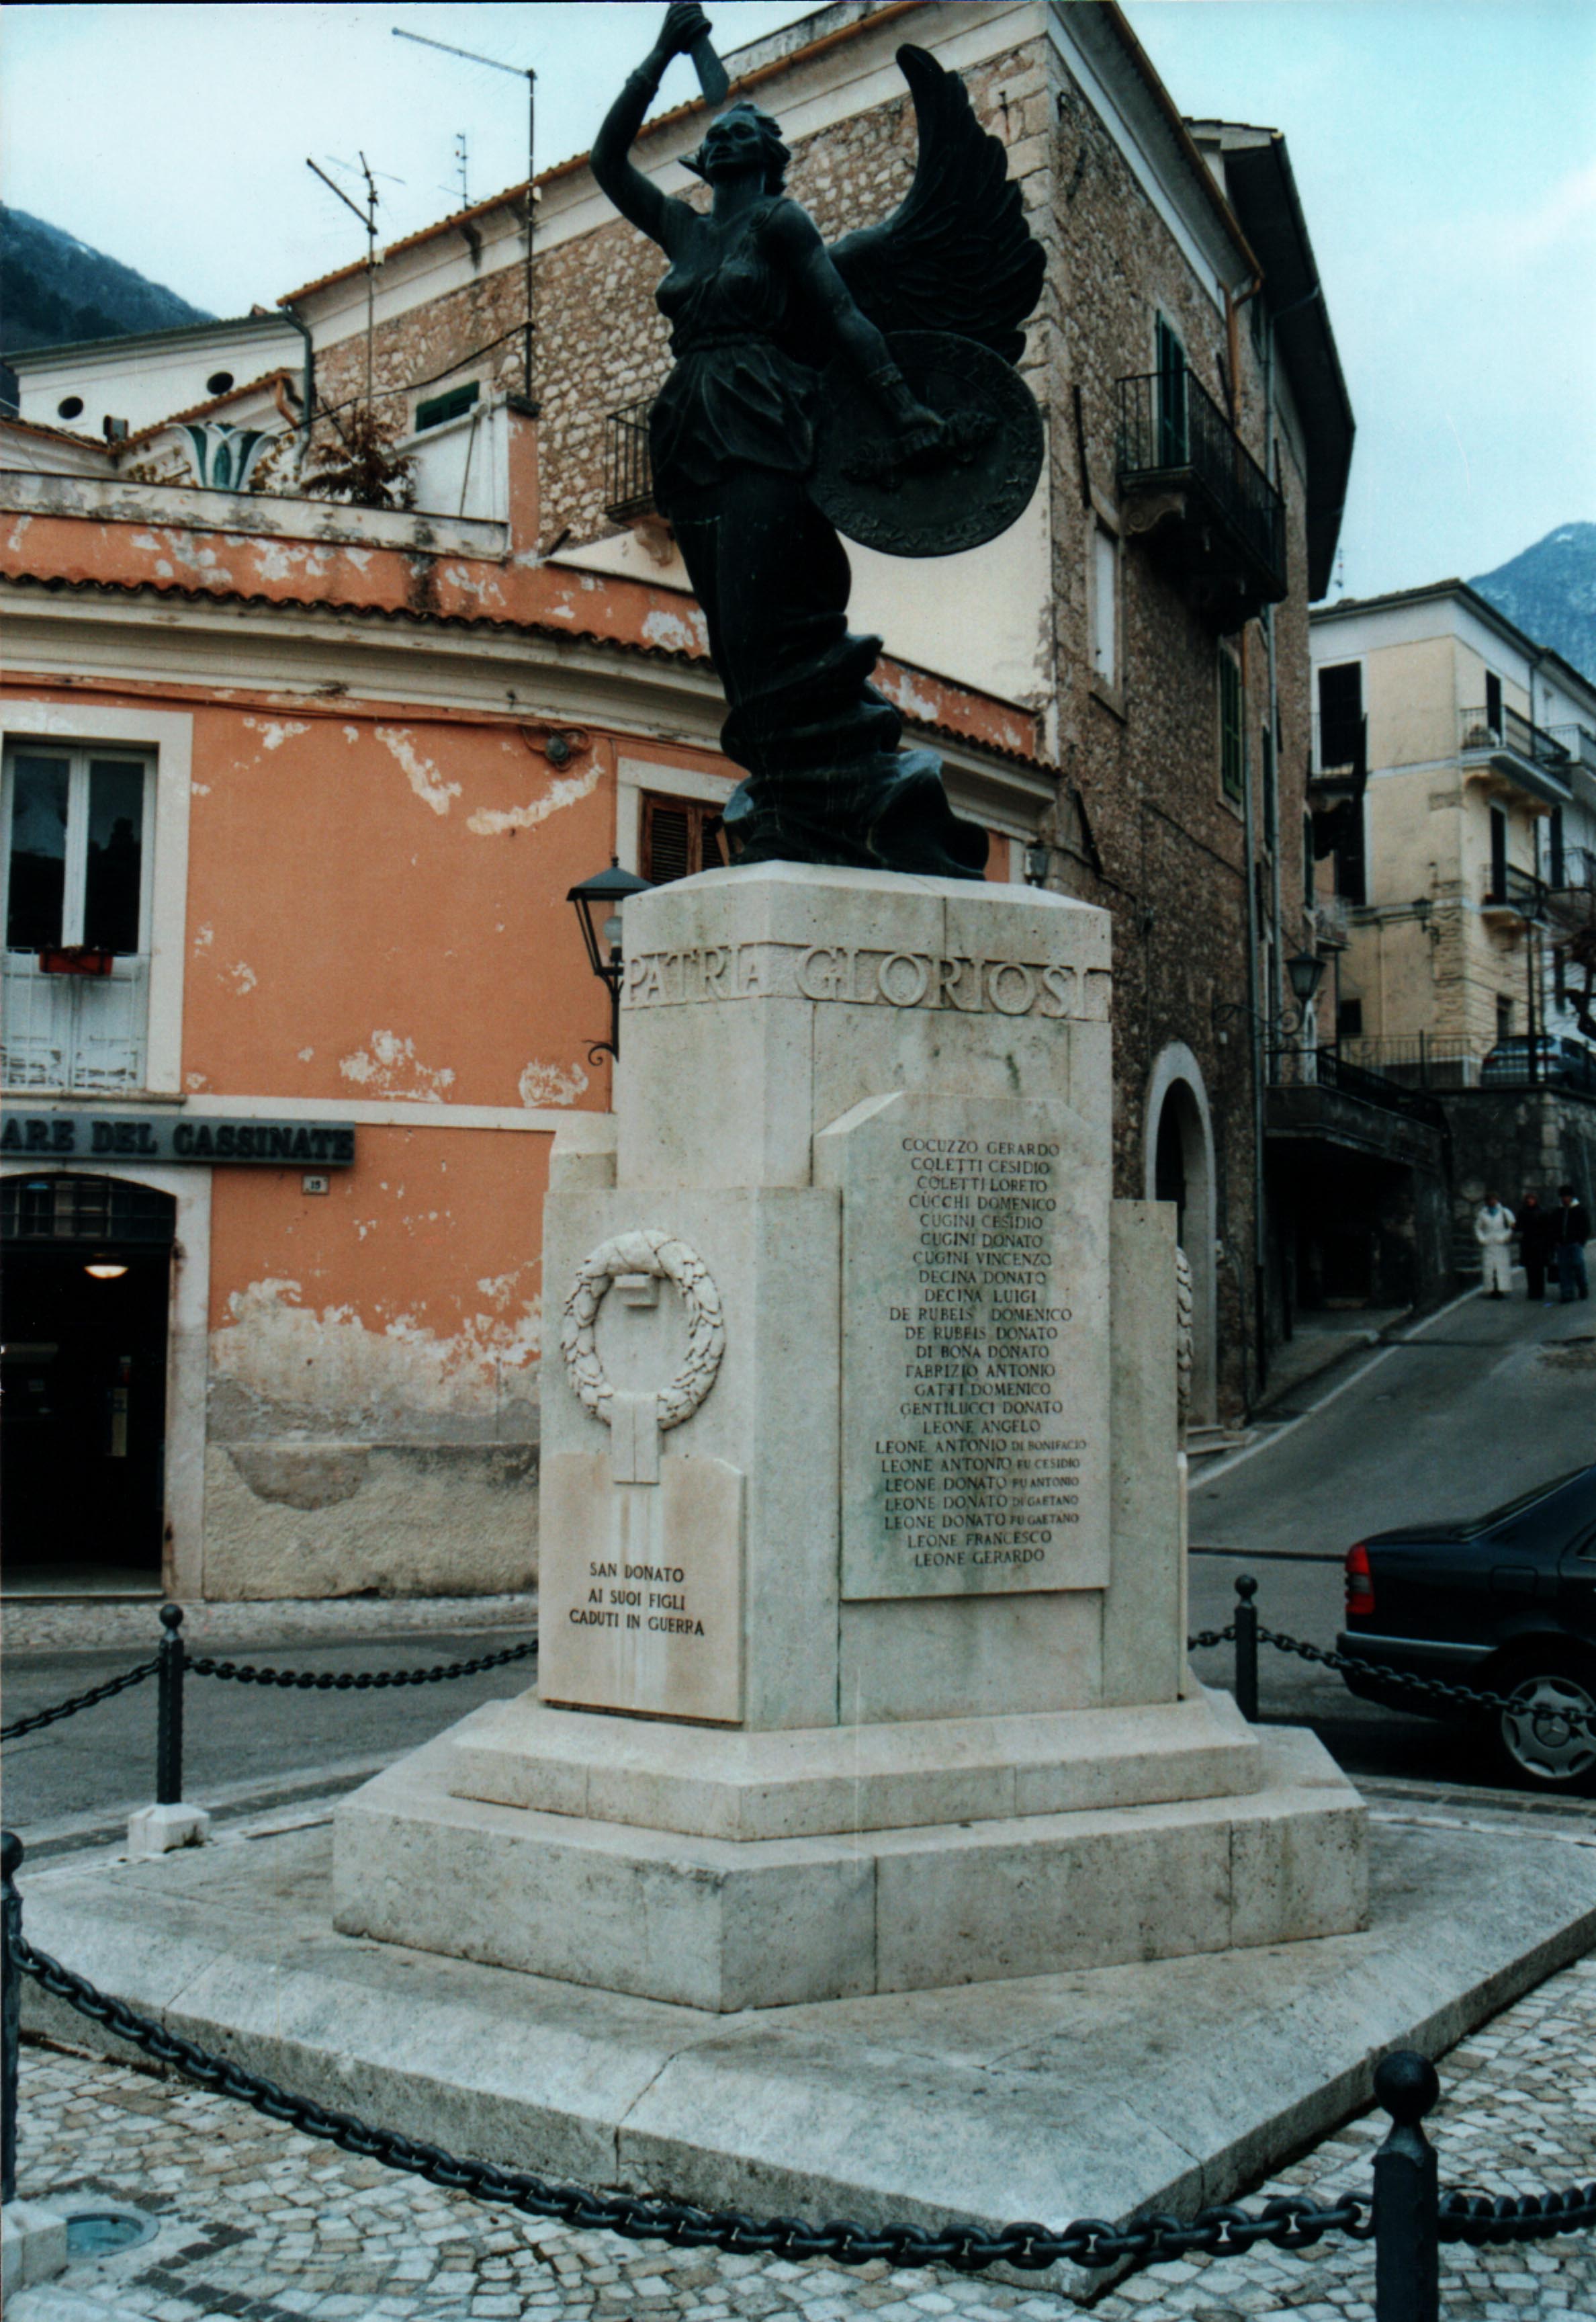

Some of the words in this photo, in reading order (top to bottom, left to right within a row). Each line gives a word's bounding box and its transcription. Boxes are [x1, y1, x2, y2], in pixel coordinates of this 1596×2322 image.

[624, 943, 767, 1008] PATRIA
[795, 944, 1089, 1020] GLORIOSI
[91, 1121, 157, 1154] DEL
[173, 1123, 354, 1160] CASSINATE
[902, 1138, 978, 1154] COCUZZO
[987, 1142, 1059, 1156] GERARDO
[911, 1158, 982, 1173] COLETTI
[989, 1160, 1050, 1174] CESIDIO
[917, 1176, 984, 1191] COLETTI
[990, 1178, 1047, 1193] LORETO
[909, 1195, 969, 1209] CUCCHI
[978, 1197, 1056, 1211] DOMENICO
[920, 1214, 975, 1228] CUGINI
[982, 1215, 1043, 1229] CESIDIO
[921, 1233, 975, 1246] CUGINI
[983, 1234, 1043, 1248] DONATO
[913, 1252, 968, 1265] CUGINI
[975, 1252, 1051, 1266] VINCENZO
[920, 1271, 976, 1283] DECINA
[984, 1272, 1046, 1285] DONATO
[925, 1289, 982, 1303] DECINA
[994, 1290, 1036, 1303] LUIGI
[890, 1307, 910, 1320] DE
[919, 1307, 973, 1320] RUBEIS
[991, 1308, 1072, 1322] DOMENICO
[905, 1327, 925, 1340] DE
[934, 1327, 985, 1340] RUBEIS
[997, 1327, 1057, 1340] DONATO
[916, 1345, 932, 1358] DI
[941, 1345, 980, 1358] BONA
[989, 1345, 1049, 1358] DONATO
[906, 1365, 978, 1378] FABRIZIO
[986, 1364, 1055, 1377] ANTONIO
[915, 1383, 963, 1396] GATTI
[971, 1383, 1050, 1395] DOMENICO
[900, 1402, 994, 1416] GENTILUCCI
[1003, 1401, 1063, 1414] DONATO
[924, 1420, 973, 1434] LEONE
[981, 1420, 1040, 1433] ANGELO
[876, 1440, 926, 1454] LEONE
[935, 1439, 1007, 1453] ANTONIO
[1012, 1442, 1024, 1451] DI
[1028, 1439, 1087, 1451] BONIFACIO
[882, 1459, 932, 1473] LEONE
[940, 1458, 1011, 1471] ANTONIO
[1017, 1459, 1030, 1469] FU
[1034, 1458, 1080, 1469] CESIDIO
[885, 1478, 935, 1492] LEONE
[944, 1477, 1006, 1490] DONATO
[1013, 1478, 1026, 1488] FU
[1030, 1477, 1079, 1487] ANTONIO
[885, 1497, 935, 1512] LEONE
[944, 1495, 1007, 1509] DONATO
[1013, 1498, 1024, 1506] DI
[1028, 1495, 1079, 1506] GAETANO
[885, 1516, 935, 1530] LEONE
[942, 1514, 1005, 1528] DONATO
[1010, 1514, 1024, 1525] FU
[1028, 1513, 1079, 1524] GAETANO
[908, 1535, 957, 1548] LEONE
[966, 1531, 1051, 1545] FRANCESCO
[915, 1553, 964, 1567] LEONE
[973, 1549, 1045, 1565] GERARDO
[590, 1562, 617, 1577] SAN
[625, 1565, 684, 1582] DONATO
[588, 1588, 603, 1602] AI
[611, 1590, 641, 1606] SUOI
[650, 1594, 684, 1610] FIGLI
[570, 1610, 618, 1627] CADUTI
[627, 1615, 639, 1629] IN
[648, 1617, 704, 1635] GUERRA
